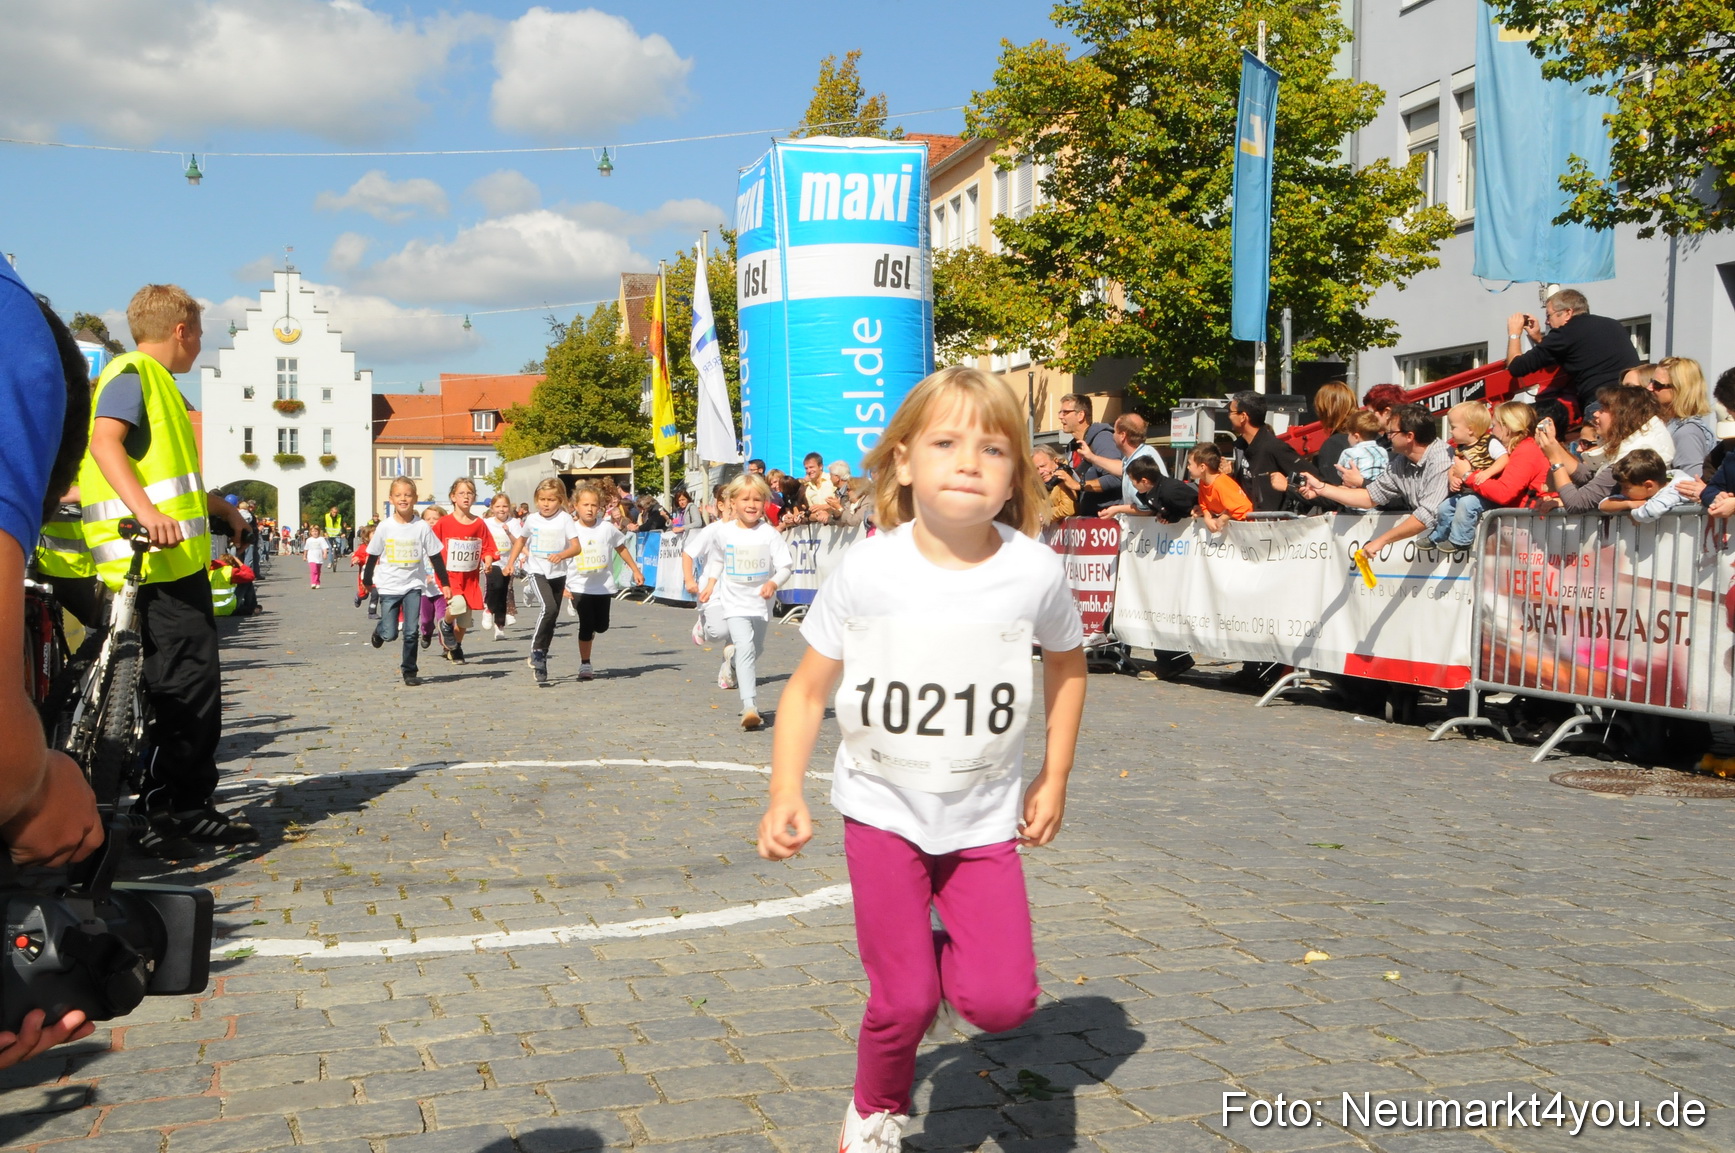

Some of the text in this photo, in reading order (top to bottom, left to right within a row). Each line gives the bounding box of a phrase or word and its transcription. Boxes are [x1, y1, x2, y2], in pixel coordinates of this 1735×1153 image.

[799, 164, 913, 222] maxi
[744, 259, 767, 298] dsl
[873, 253, 912, 290] dsl
[1090, 527, 1117, 547] 390
[1126, 531, 1151, 554] Gute
[1156, 532, 1190, 555] Ideen
[1195, 538, 1235, 558] haben
[1259, 537, 1331, 561] Zuhause.
[396, 549, 419, 557] 7213
[450, 550, 480, 562] 10216
[585, 554, 607, 565] 7003
[736, 558, 767, 570] 7066
[1216, 613, 1249, 632] Telefon:
[1252, 617, 1280, 635] 09181
[1519, 600, 1569, 636] SEAT
[1578, 605, 1647, 643] IBIZA
[855, 676, 1016, 737] 10218
